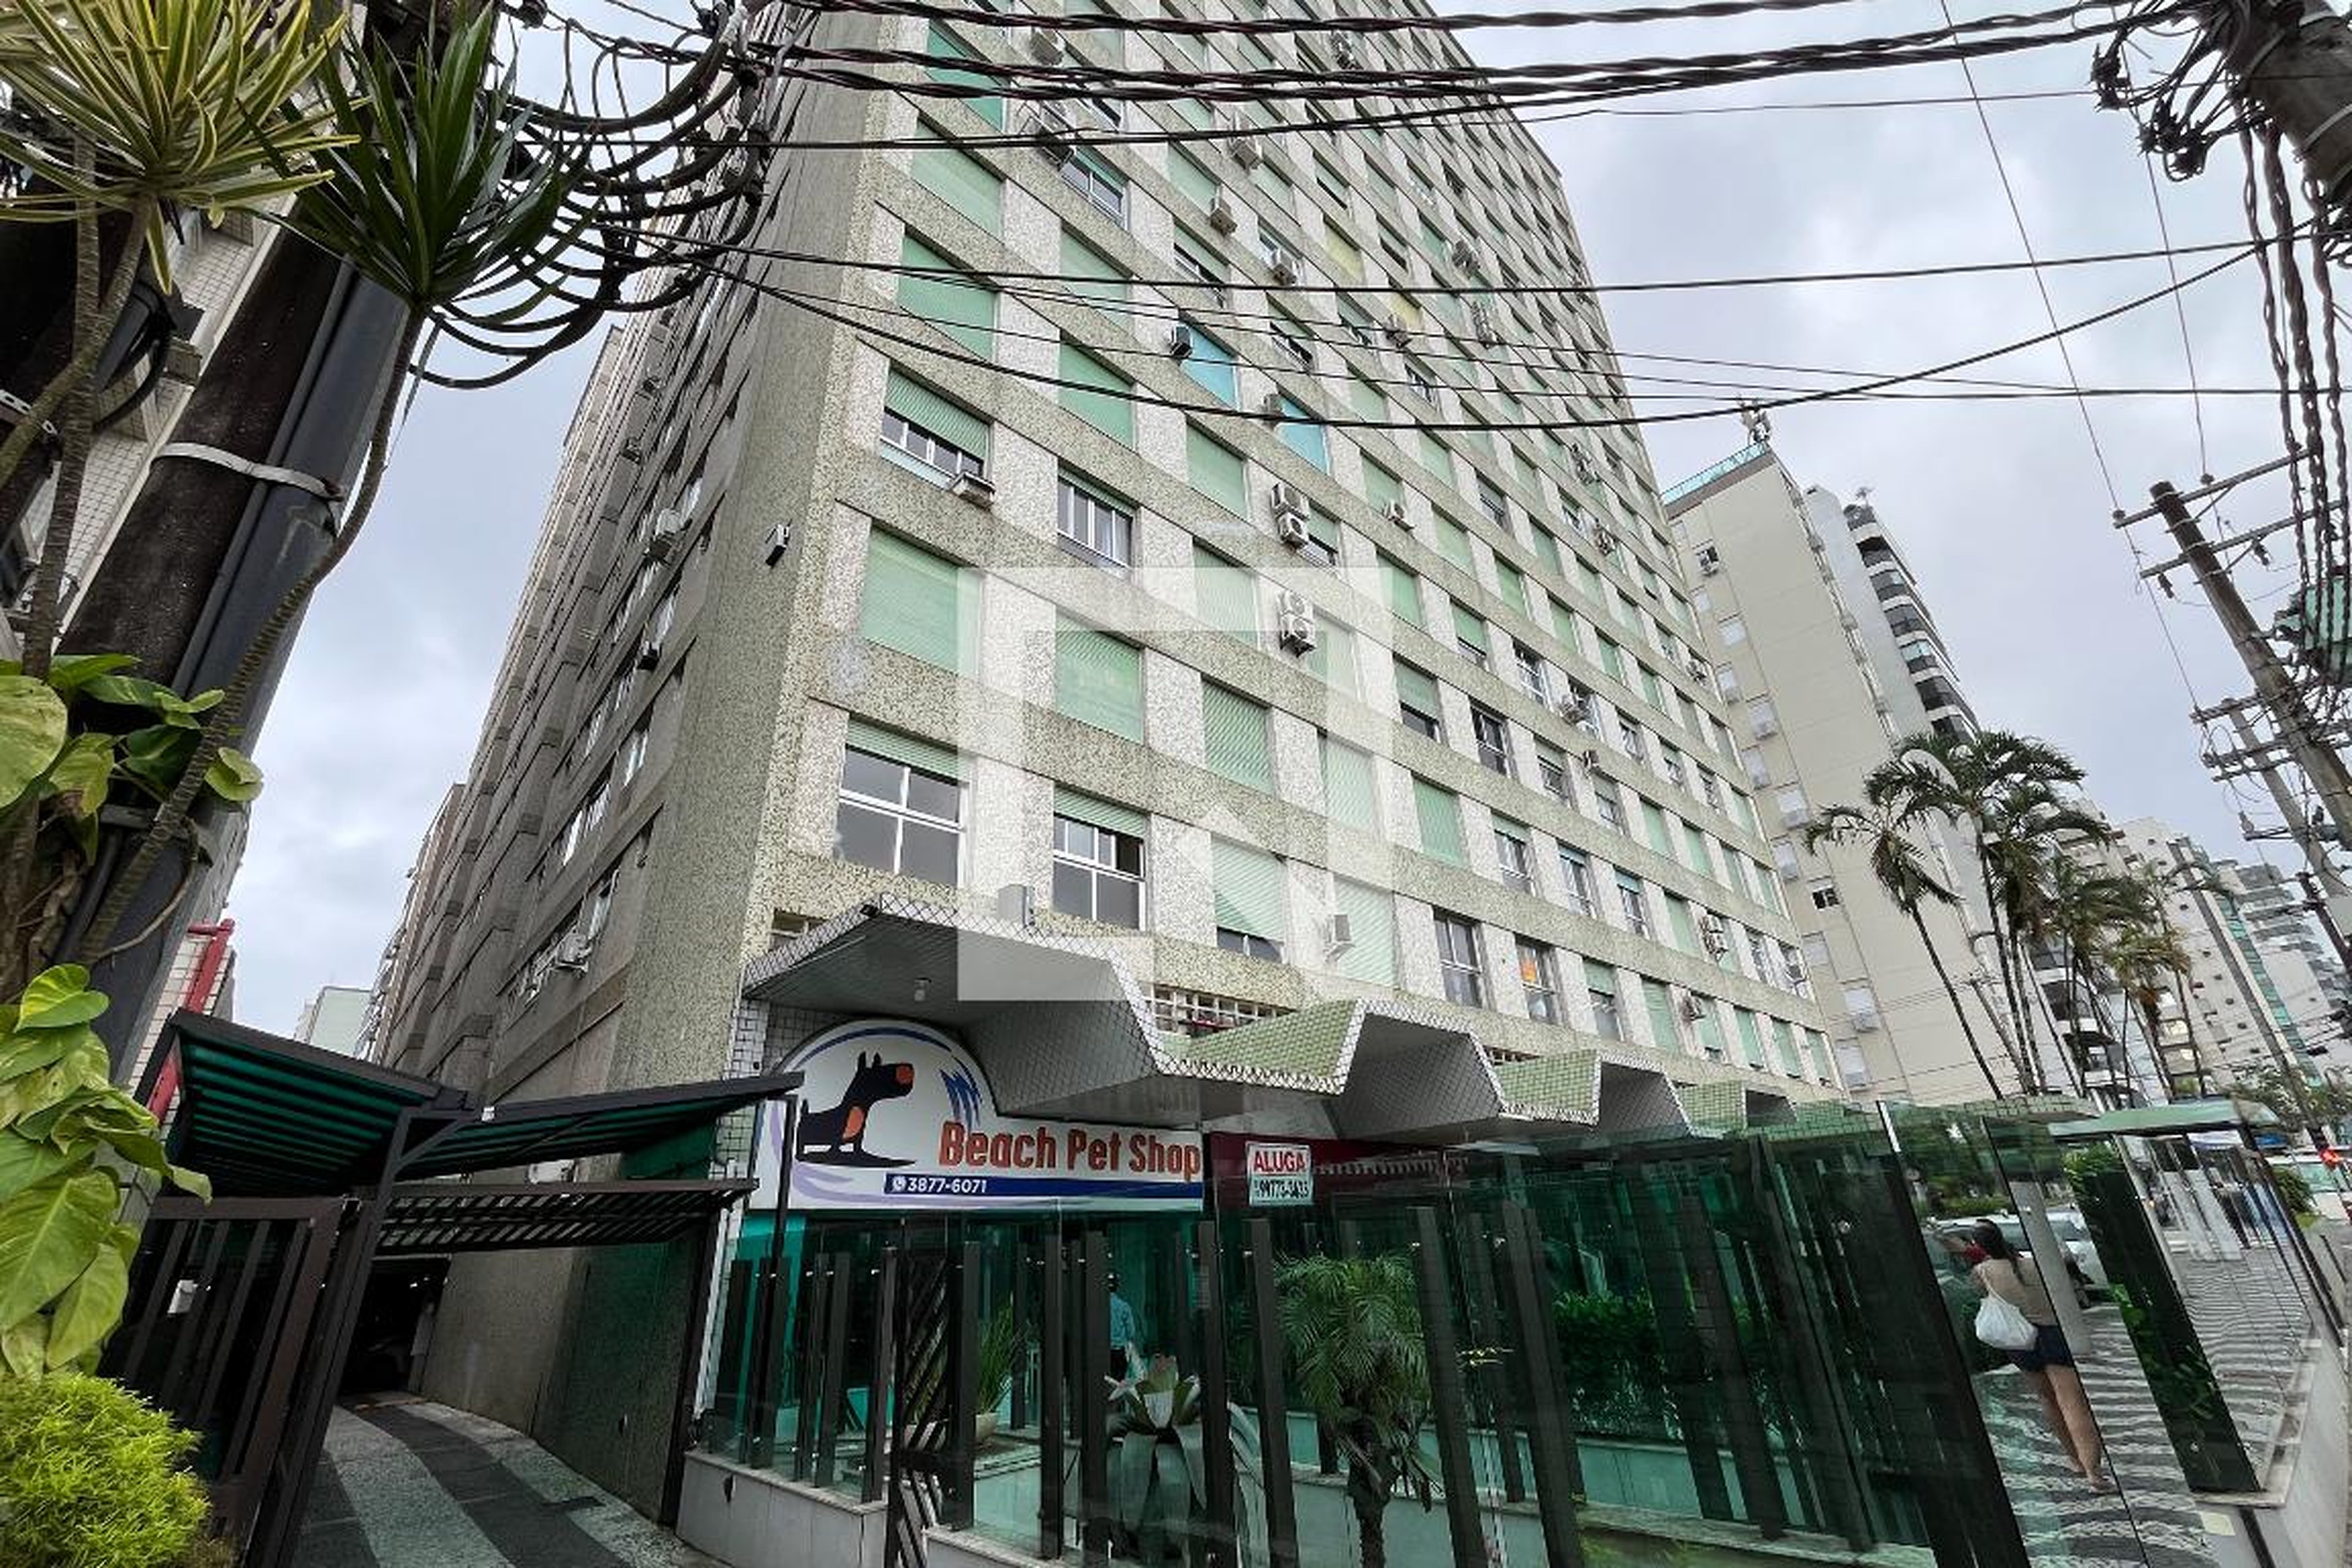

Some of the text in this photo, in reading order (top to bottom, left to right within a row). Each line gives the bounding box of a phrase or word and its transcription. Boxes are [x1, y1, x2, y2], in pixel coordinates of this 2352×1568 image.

[939, 1121, 1201, 1183] Beach Pet Shop
[1254, 1151, 1307, 1172] ALUGA
[907, 1177, 987, 1193] 3877-6071
